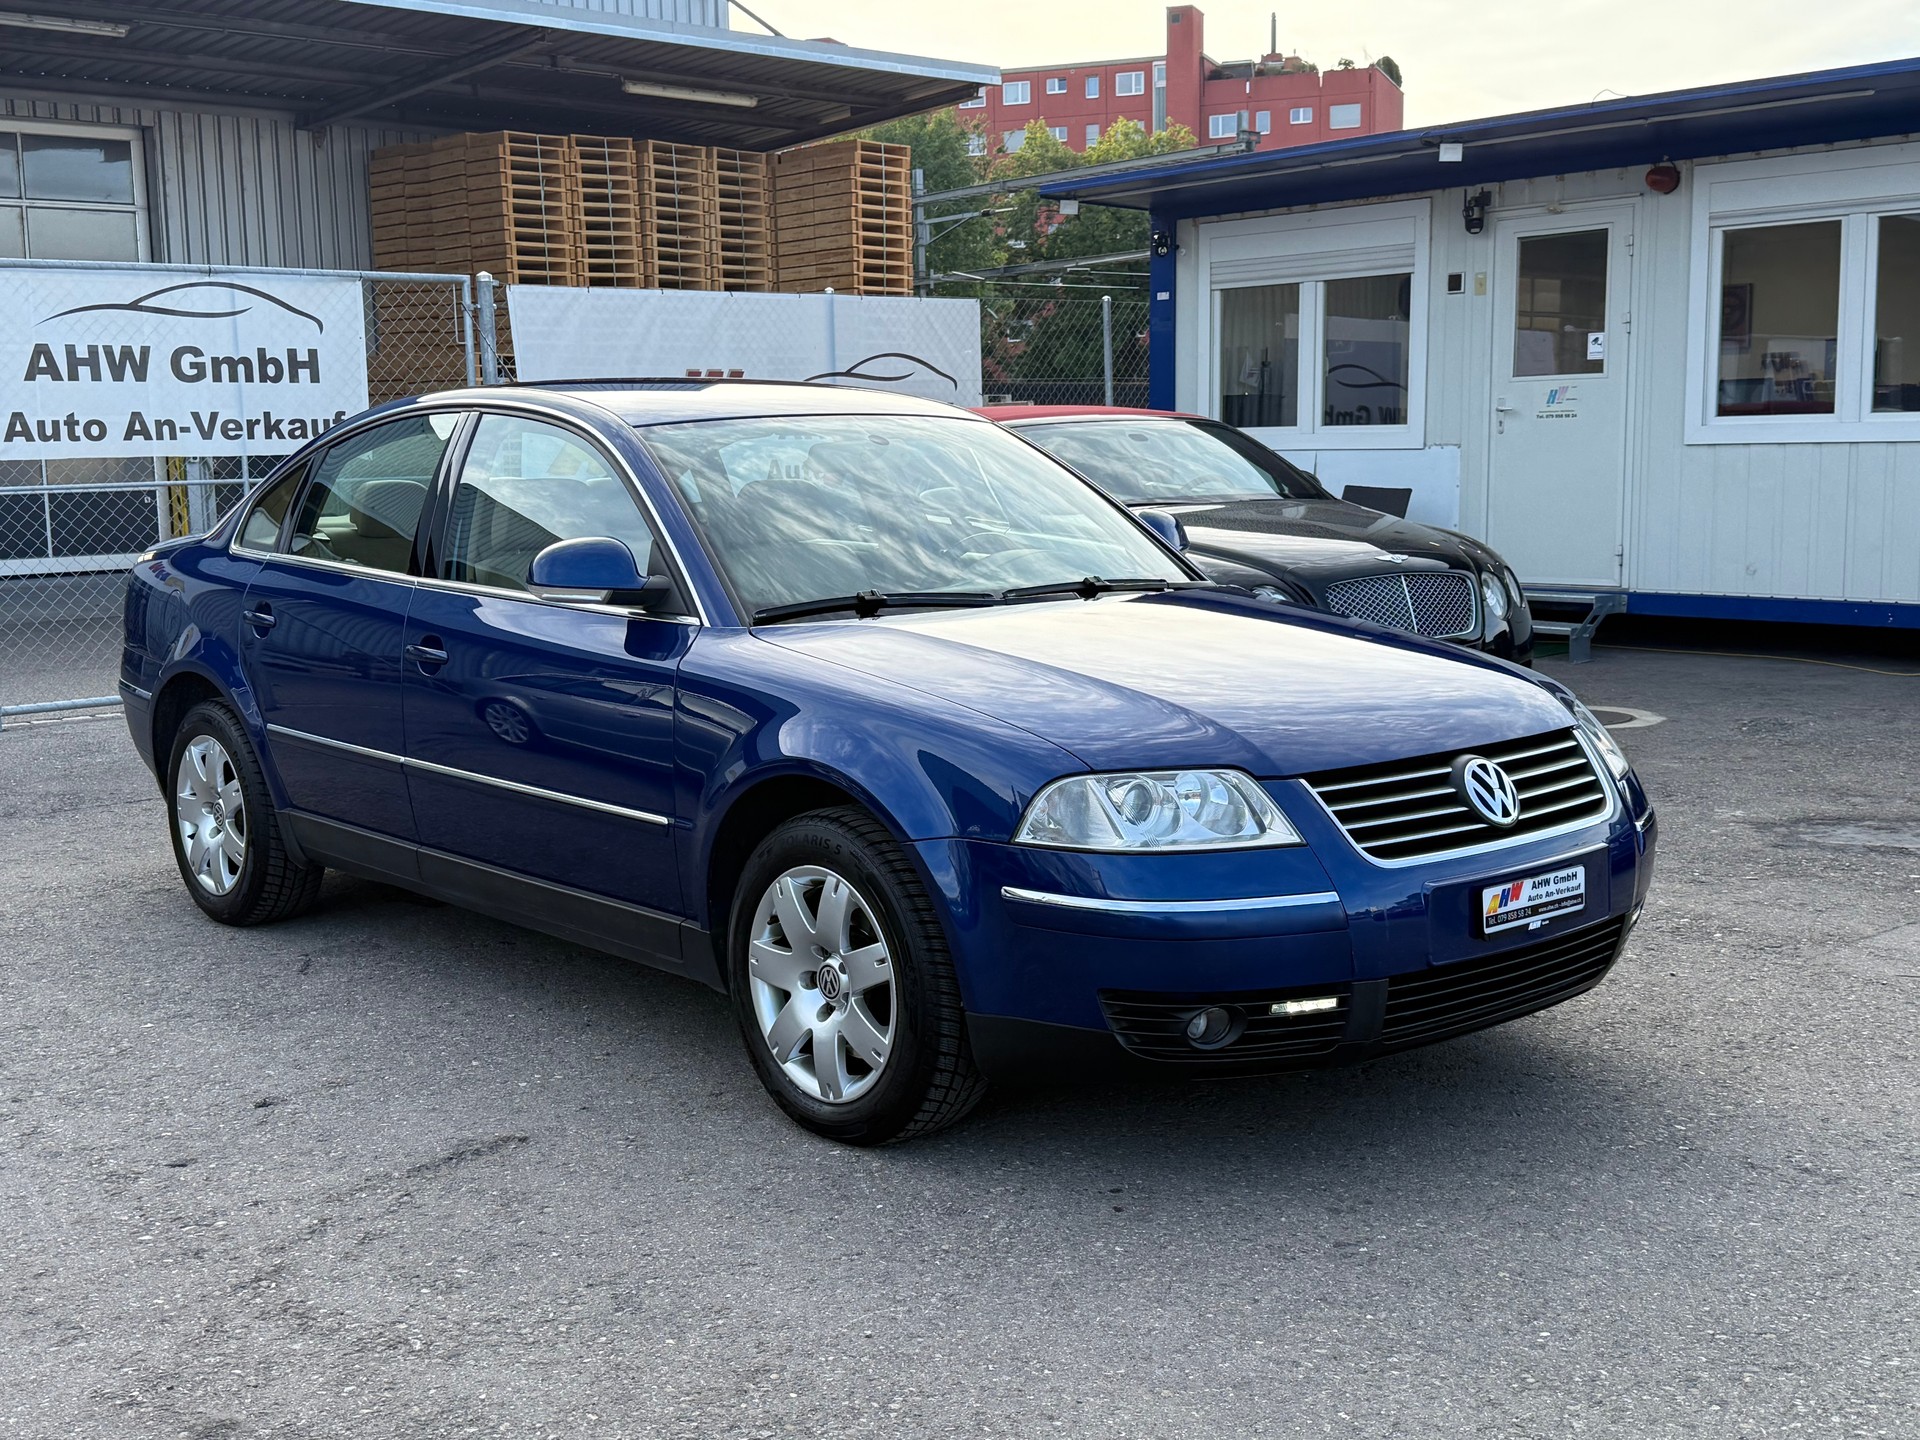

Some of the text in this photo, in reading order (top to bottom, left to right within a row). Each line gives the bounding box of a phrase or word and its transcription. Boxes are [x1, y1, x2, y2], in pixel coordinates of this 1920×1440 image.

[24, 343, 321, 384] AHW GmbH
[4, 411, 108, 443] Auto
[1527, 883, 1582, 902] Auto An-Verkauf
[1531, 871, 1578, 890] AHW GmbH
[1486, 882, 1524, 915] AHW
[1488, 907, 1532, 925] Tel. 079 858 58 24
